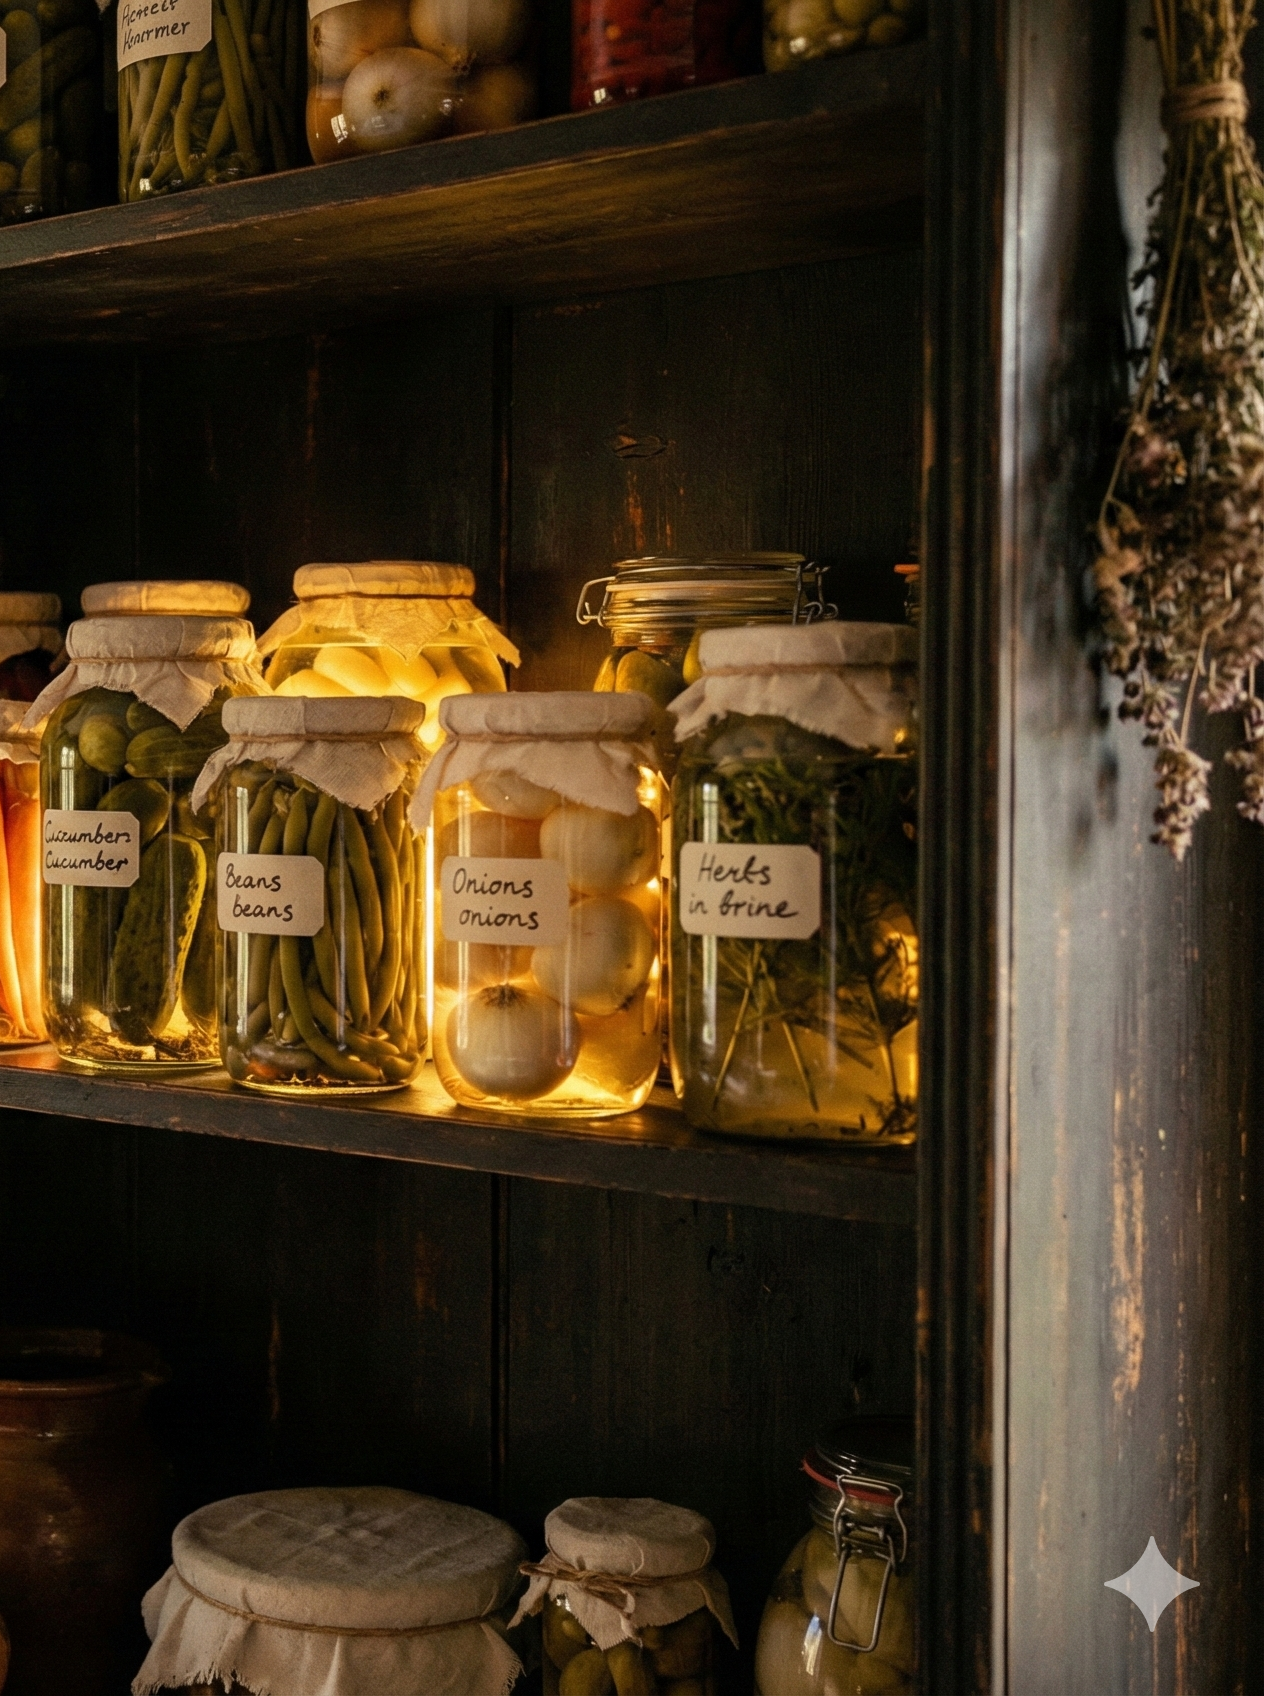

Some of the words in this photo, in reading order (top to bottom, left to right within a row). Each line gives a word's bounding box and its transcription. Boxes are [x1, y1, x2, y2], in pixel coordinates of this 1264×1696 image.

[45, 850, 129, 872] Cucumber
[225, 862, 282, 893] Beans
[452, 867, 533, 899] Onions
[232, 893, 293, 922] beans
[688, 893, 708, 915] in
[719, 889, 799, 918] brine
